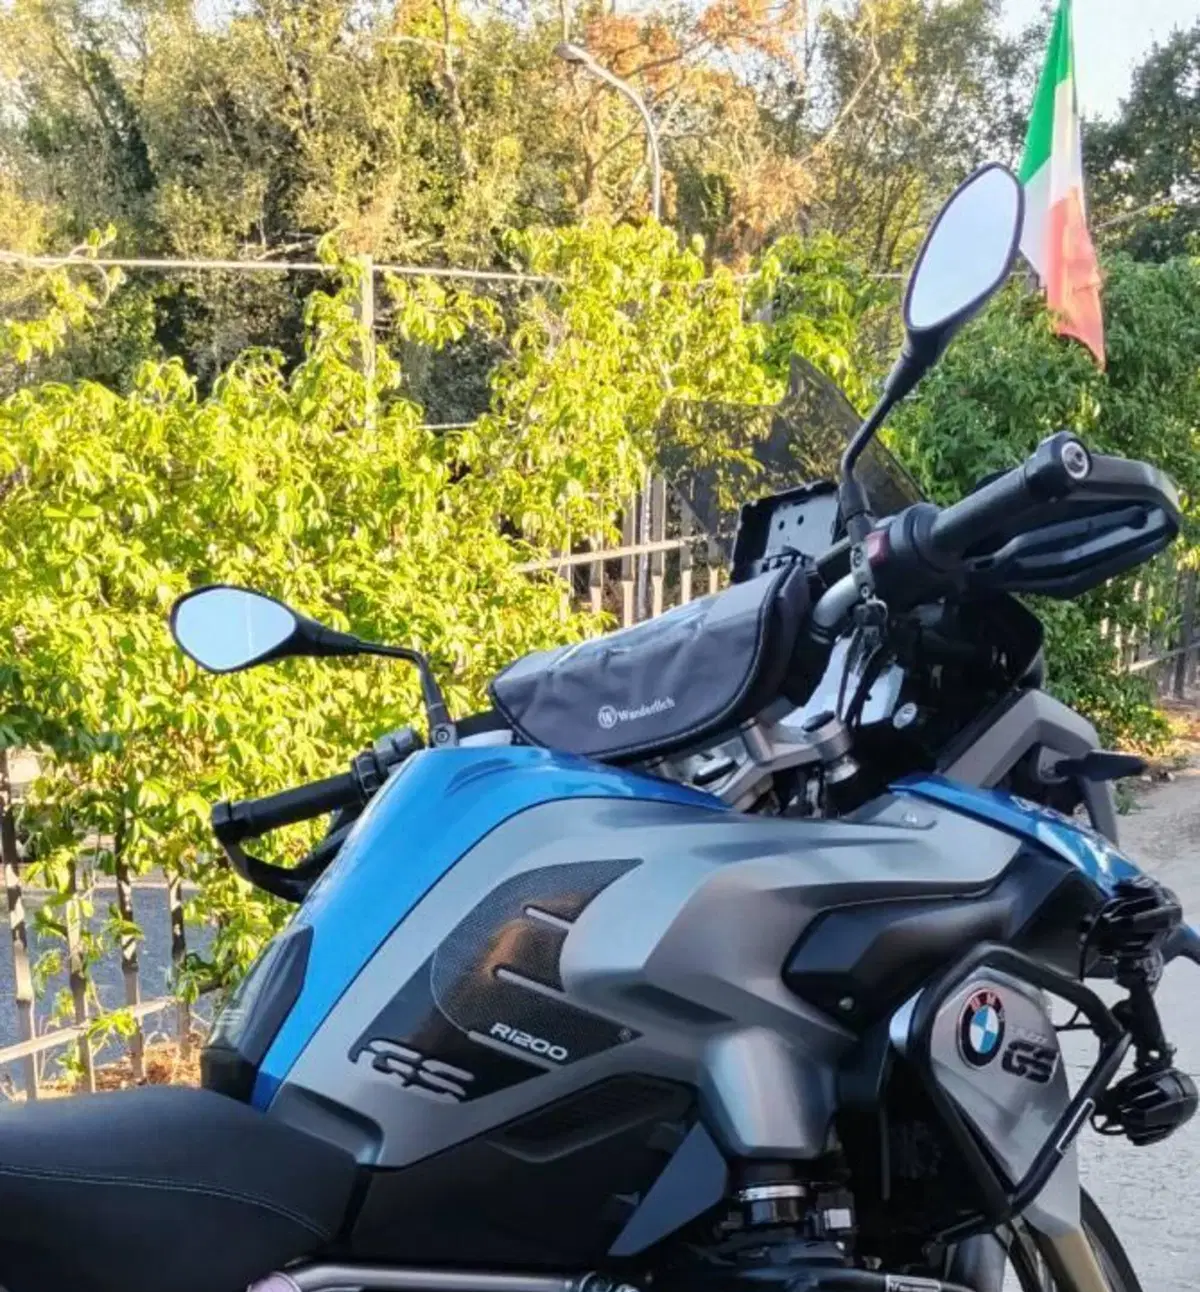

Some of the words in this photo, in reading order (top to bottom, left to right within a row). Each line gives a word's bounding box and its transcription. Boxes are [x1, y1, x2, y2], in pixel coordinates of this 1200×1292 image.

[490, 1022, 568, 1060] R1200
[1002, 1040, 1057, 1083] GS
[357, 1039, 475, 1103] GS
